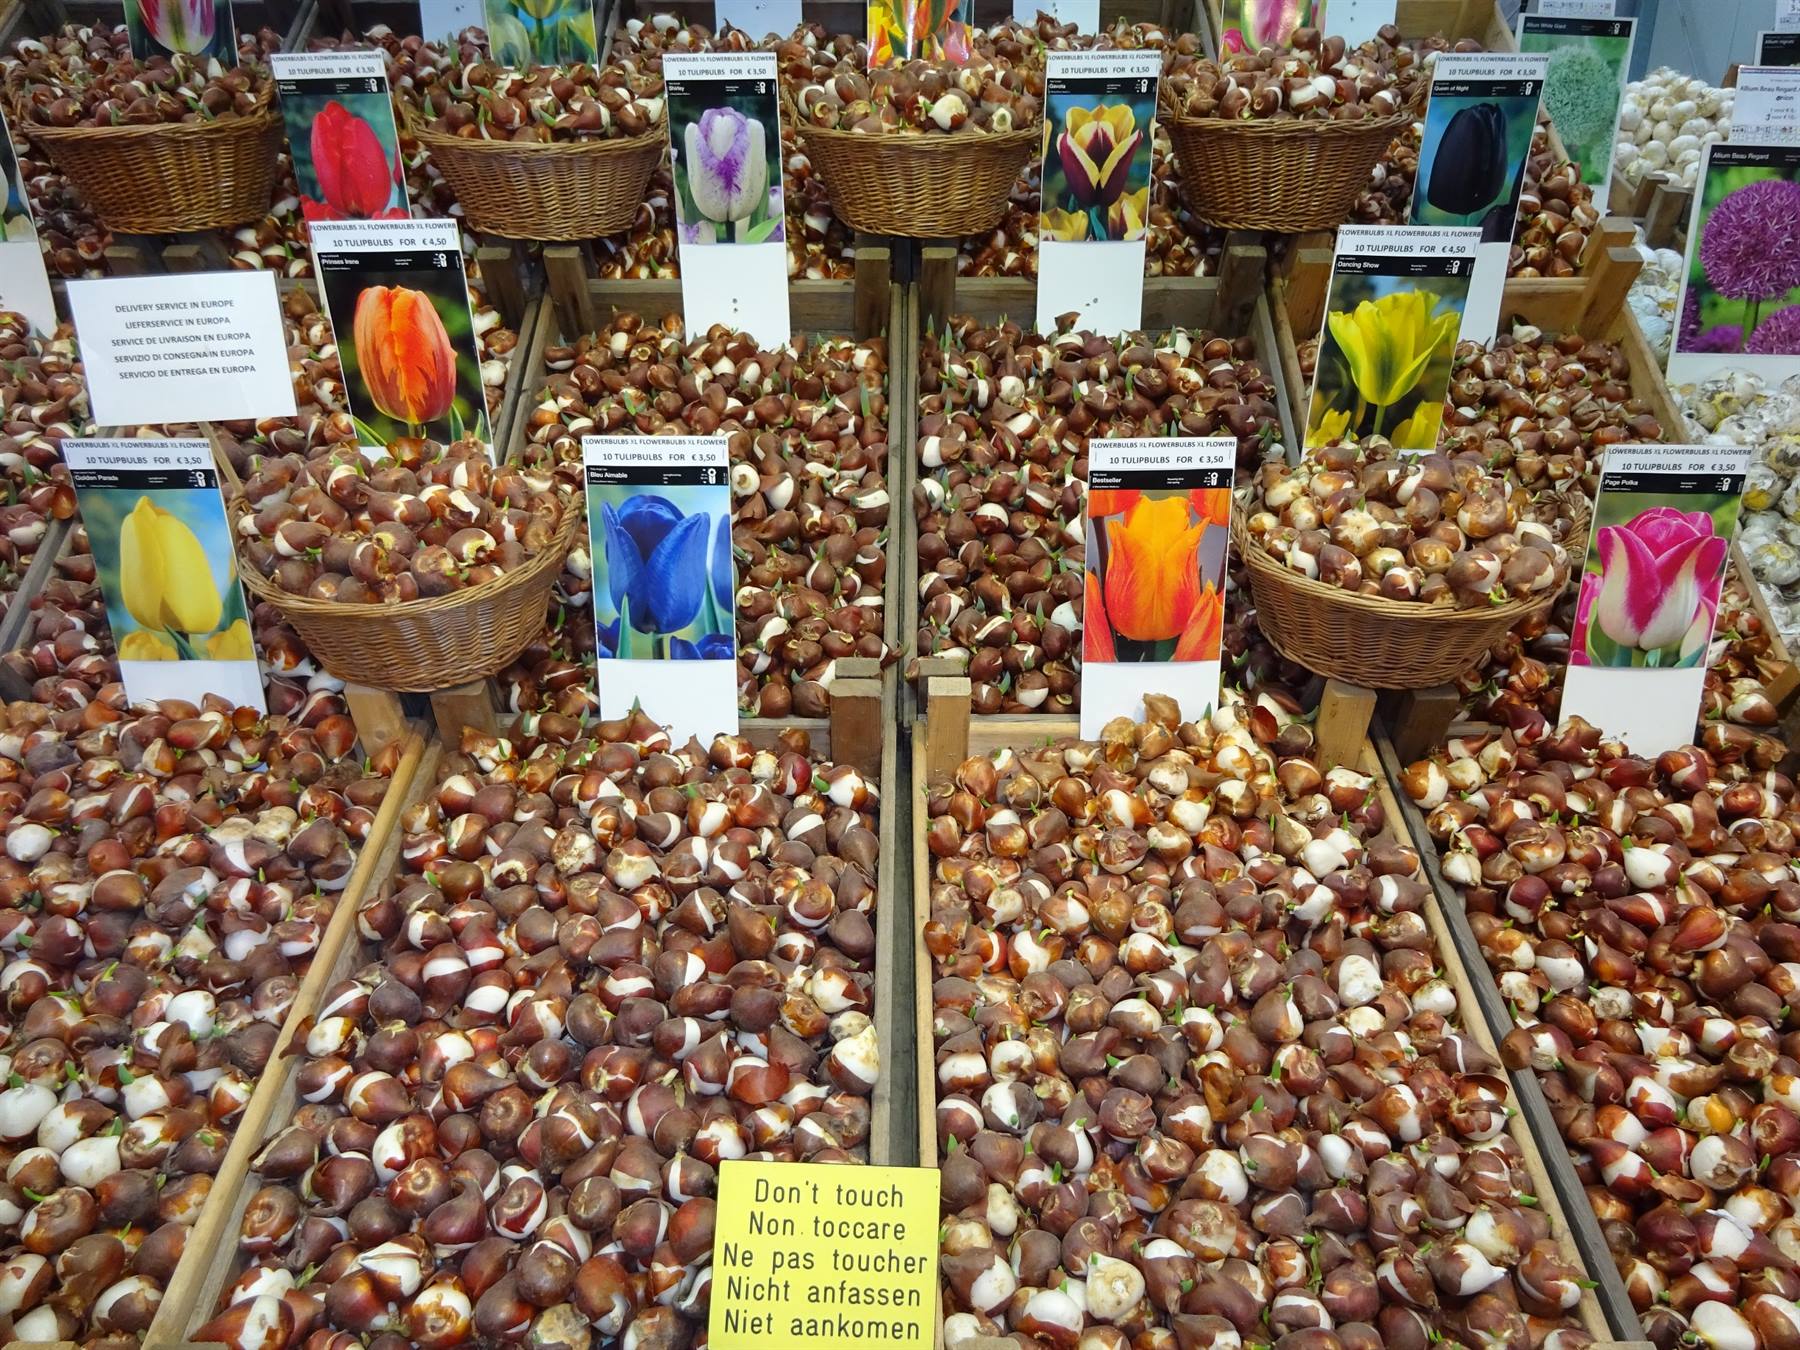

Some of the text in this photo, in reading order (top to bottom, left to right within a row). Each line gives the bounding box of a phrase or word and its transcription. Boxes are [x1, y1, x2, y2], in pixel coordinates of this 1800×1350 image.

[344, 239, 394, 247] TULIPBULBS
[1366, 245, 1413, 253] TULIPBULBS
[1420, 245, 1436, 253] FOR
[115, 304, 153, 313] DELIVERY
[155, 303, 188, 311] SERVICE
[201, 300, 234, 308] EUROPE
[125, 319, 184, 329] LIEFERSERVICE
[196, 317, 231, 325] EUROPA
[112, 338, 144, 347] SERVICE
[146, 337, 157, 345] DE
[159, 335, 202, 344] LIVRAISON
[216, 333, 251, 341] EUROPA
[114, 354, 150, 363] SERVIZIO
[163, 351, 208, 360] CONSEGNA
[220, 349, 255, 358] EUROPA
[119, 371, 156, 379] SERVICIO
[158, 369, 169, 378] DE
[170, 368, 208, 377] ENTREGA
[222, 365, 256, 374] EUROPA
[98, 456, 148, 464] TULIPBULBS
[602, 453, 613, 461] 10
[615, 453, 663, 461] TULIPBULBS
[1121, 456, 1170, 464] TULIPBULBS
[1634, 463, 1682, 471] TULIPBULBS
[755, 1178, 904, 1208] Don't touch
[749, 1211, 906, 1240] Non toccare
[723, 1242, 929, 1275] Ne pas toucher
[727, 1275, 921, 1307] Nicht anfassen
[724, 1309, 920, 1340] Niet aankomen
